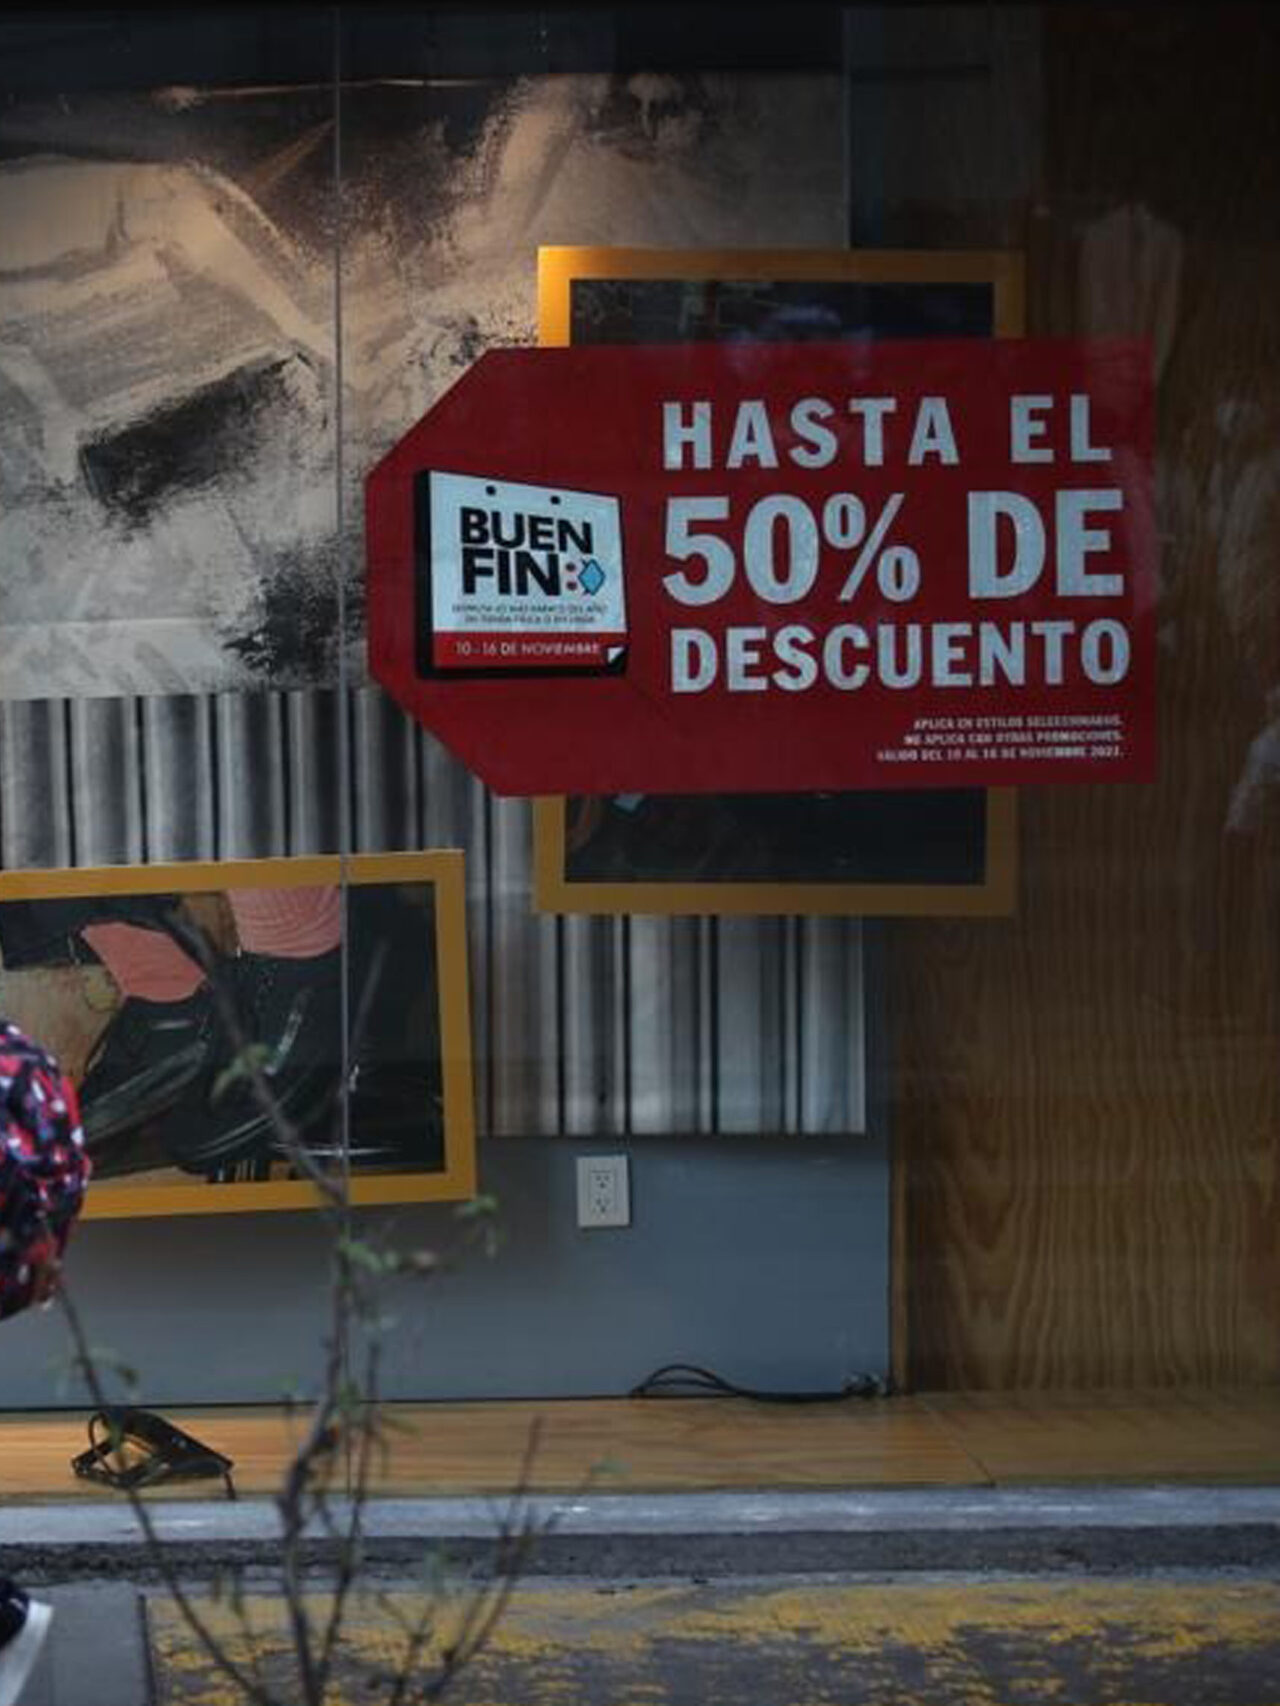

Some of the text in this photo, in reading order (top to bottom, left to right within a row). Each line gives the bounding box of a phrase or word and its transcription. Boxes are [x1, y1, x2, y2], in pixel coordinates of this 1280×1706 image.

[663, 395, 1113, 470] HASTA EL
[460, 506, 594, 555] BUEN
[662, 489, 1125, 606] 50% DE
[462, 546, 561, 597] FIN
[501, 641, 518, 655] DE
[522, 641, 601, 655] NOVIEMBRE
[671, 618, 1131, 693] DESCUENTO
